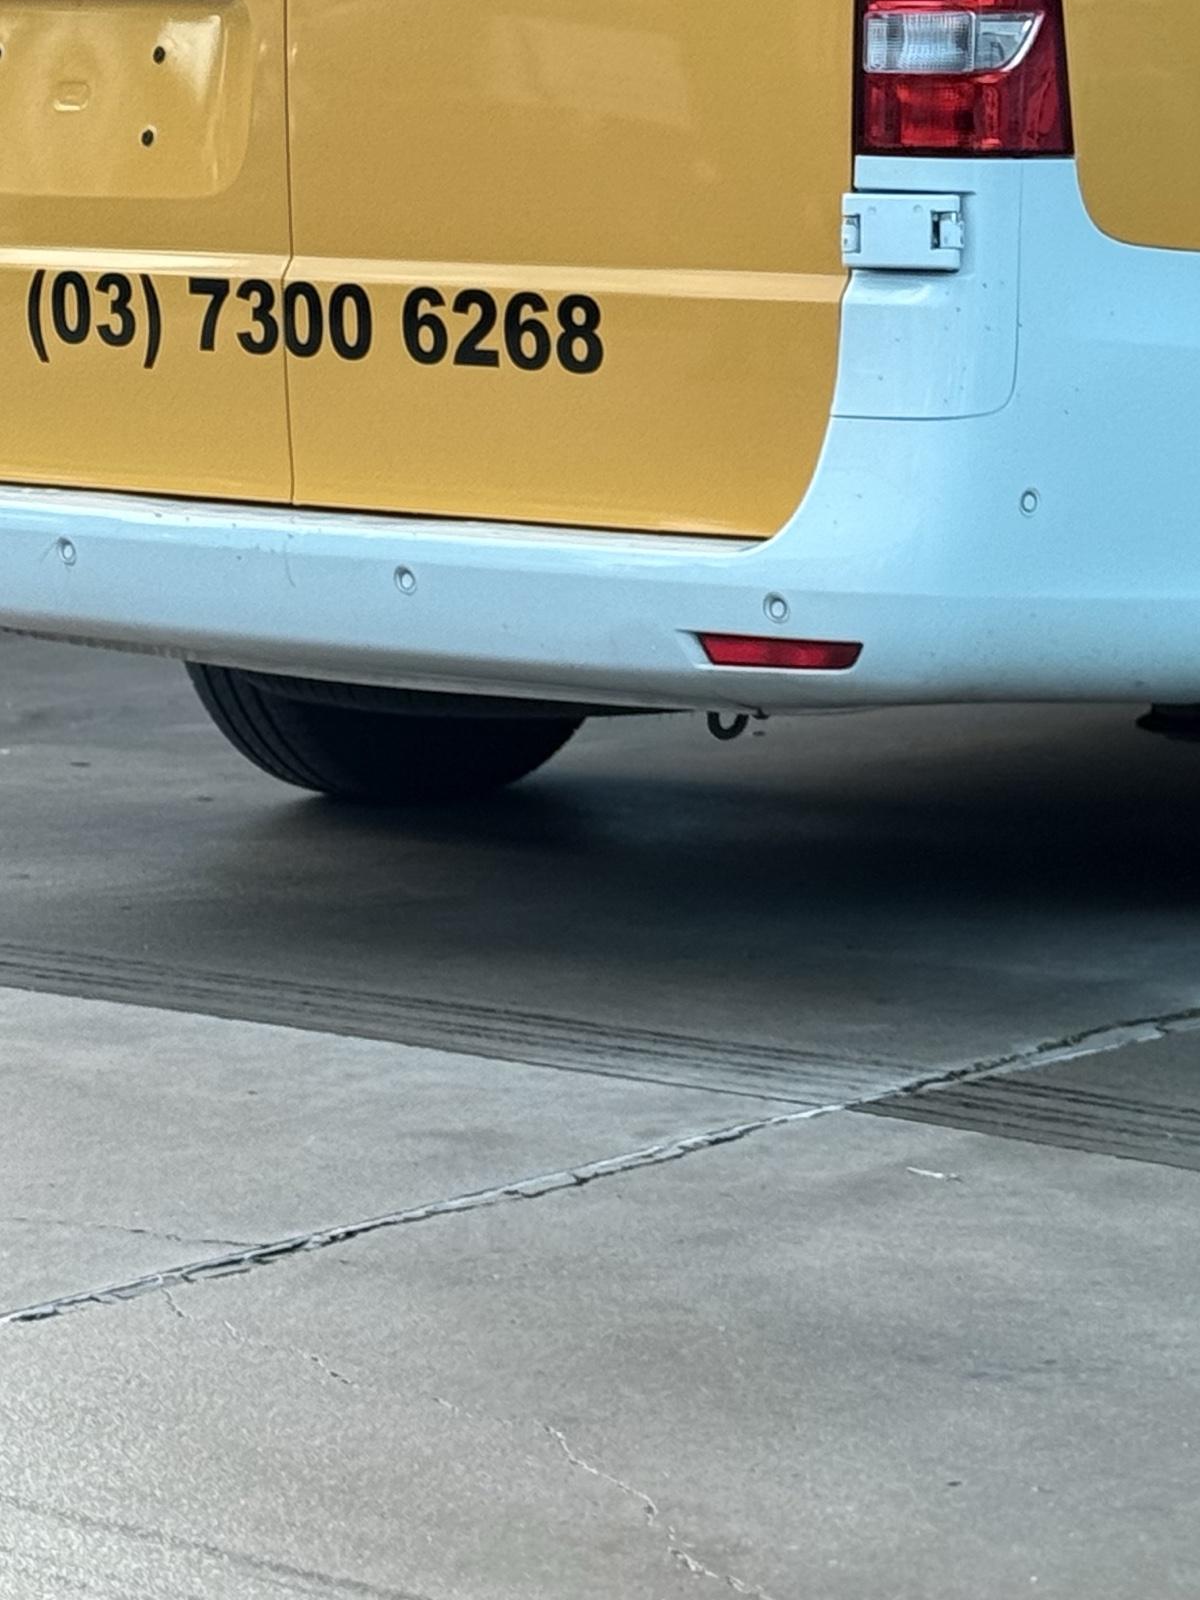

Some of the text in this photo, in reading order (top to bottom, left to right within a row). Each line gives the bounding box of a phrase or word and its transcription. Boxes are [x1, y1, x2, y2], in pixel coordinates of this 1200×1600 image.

[27, 268, 604, 374] (03) 7300 6268
